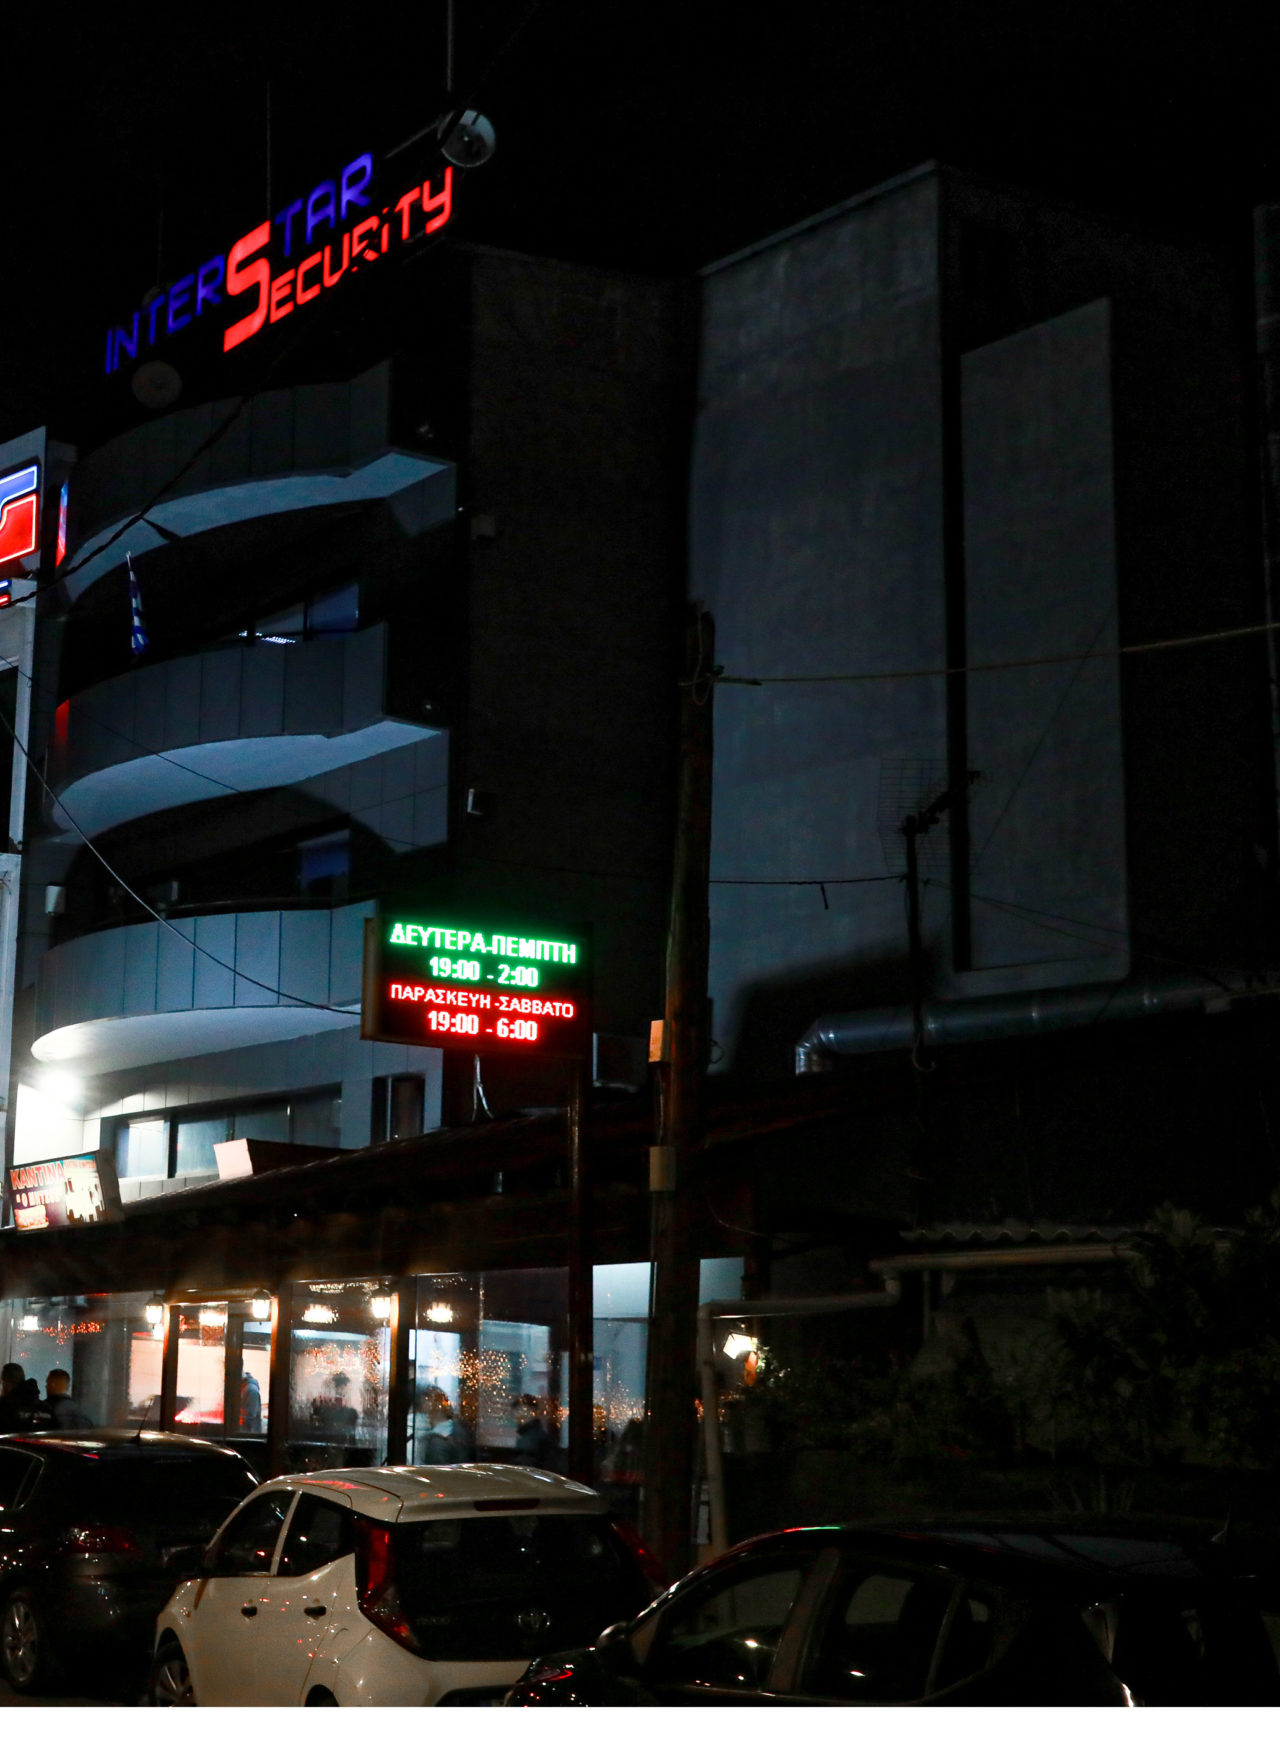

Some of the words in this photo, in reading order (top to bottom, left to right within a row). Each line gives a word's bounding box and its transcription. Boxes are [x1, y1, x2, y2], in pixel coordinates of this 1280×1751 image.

[105, 152, 373, 374] INTERSTAR
[429, 956, 481, 981] 19:00
[497, 963, 539, 988] 2:00
[391, 984, 491, 1009] ΠΑΡΑΣΚΕΥΗ
[427, 1010, 480, 1035] 19:00
[496, 1017, 538, 1041] 6:00
